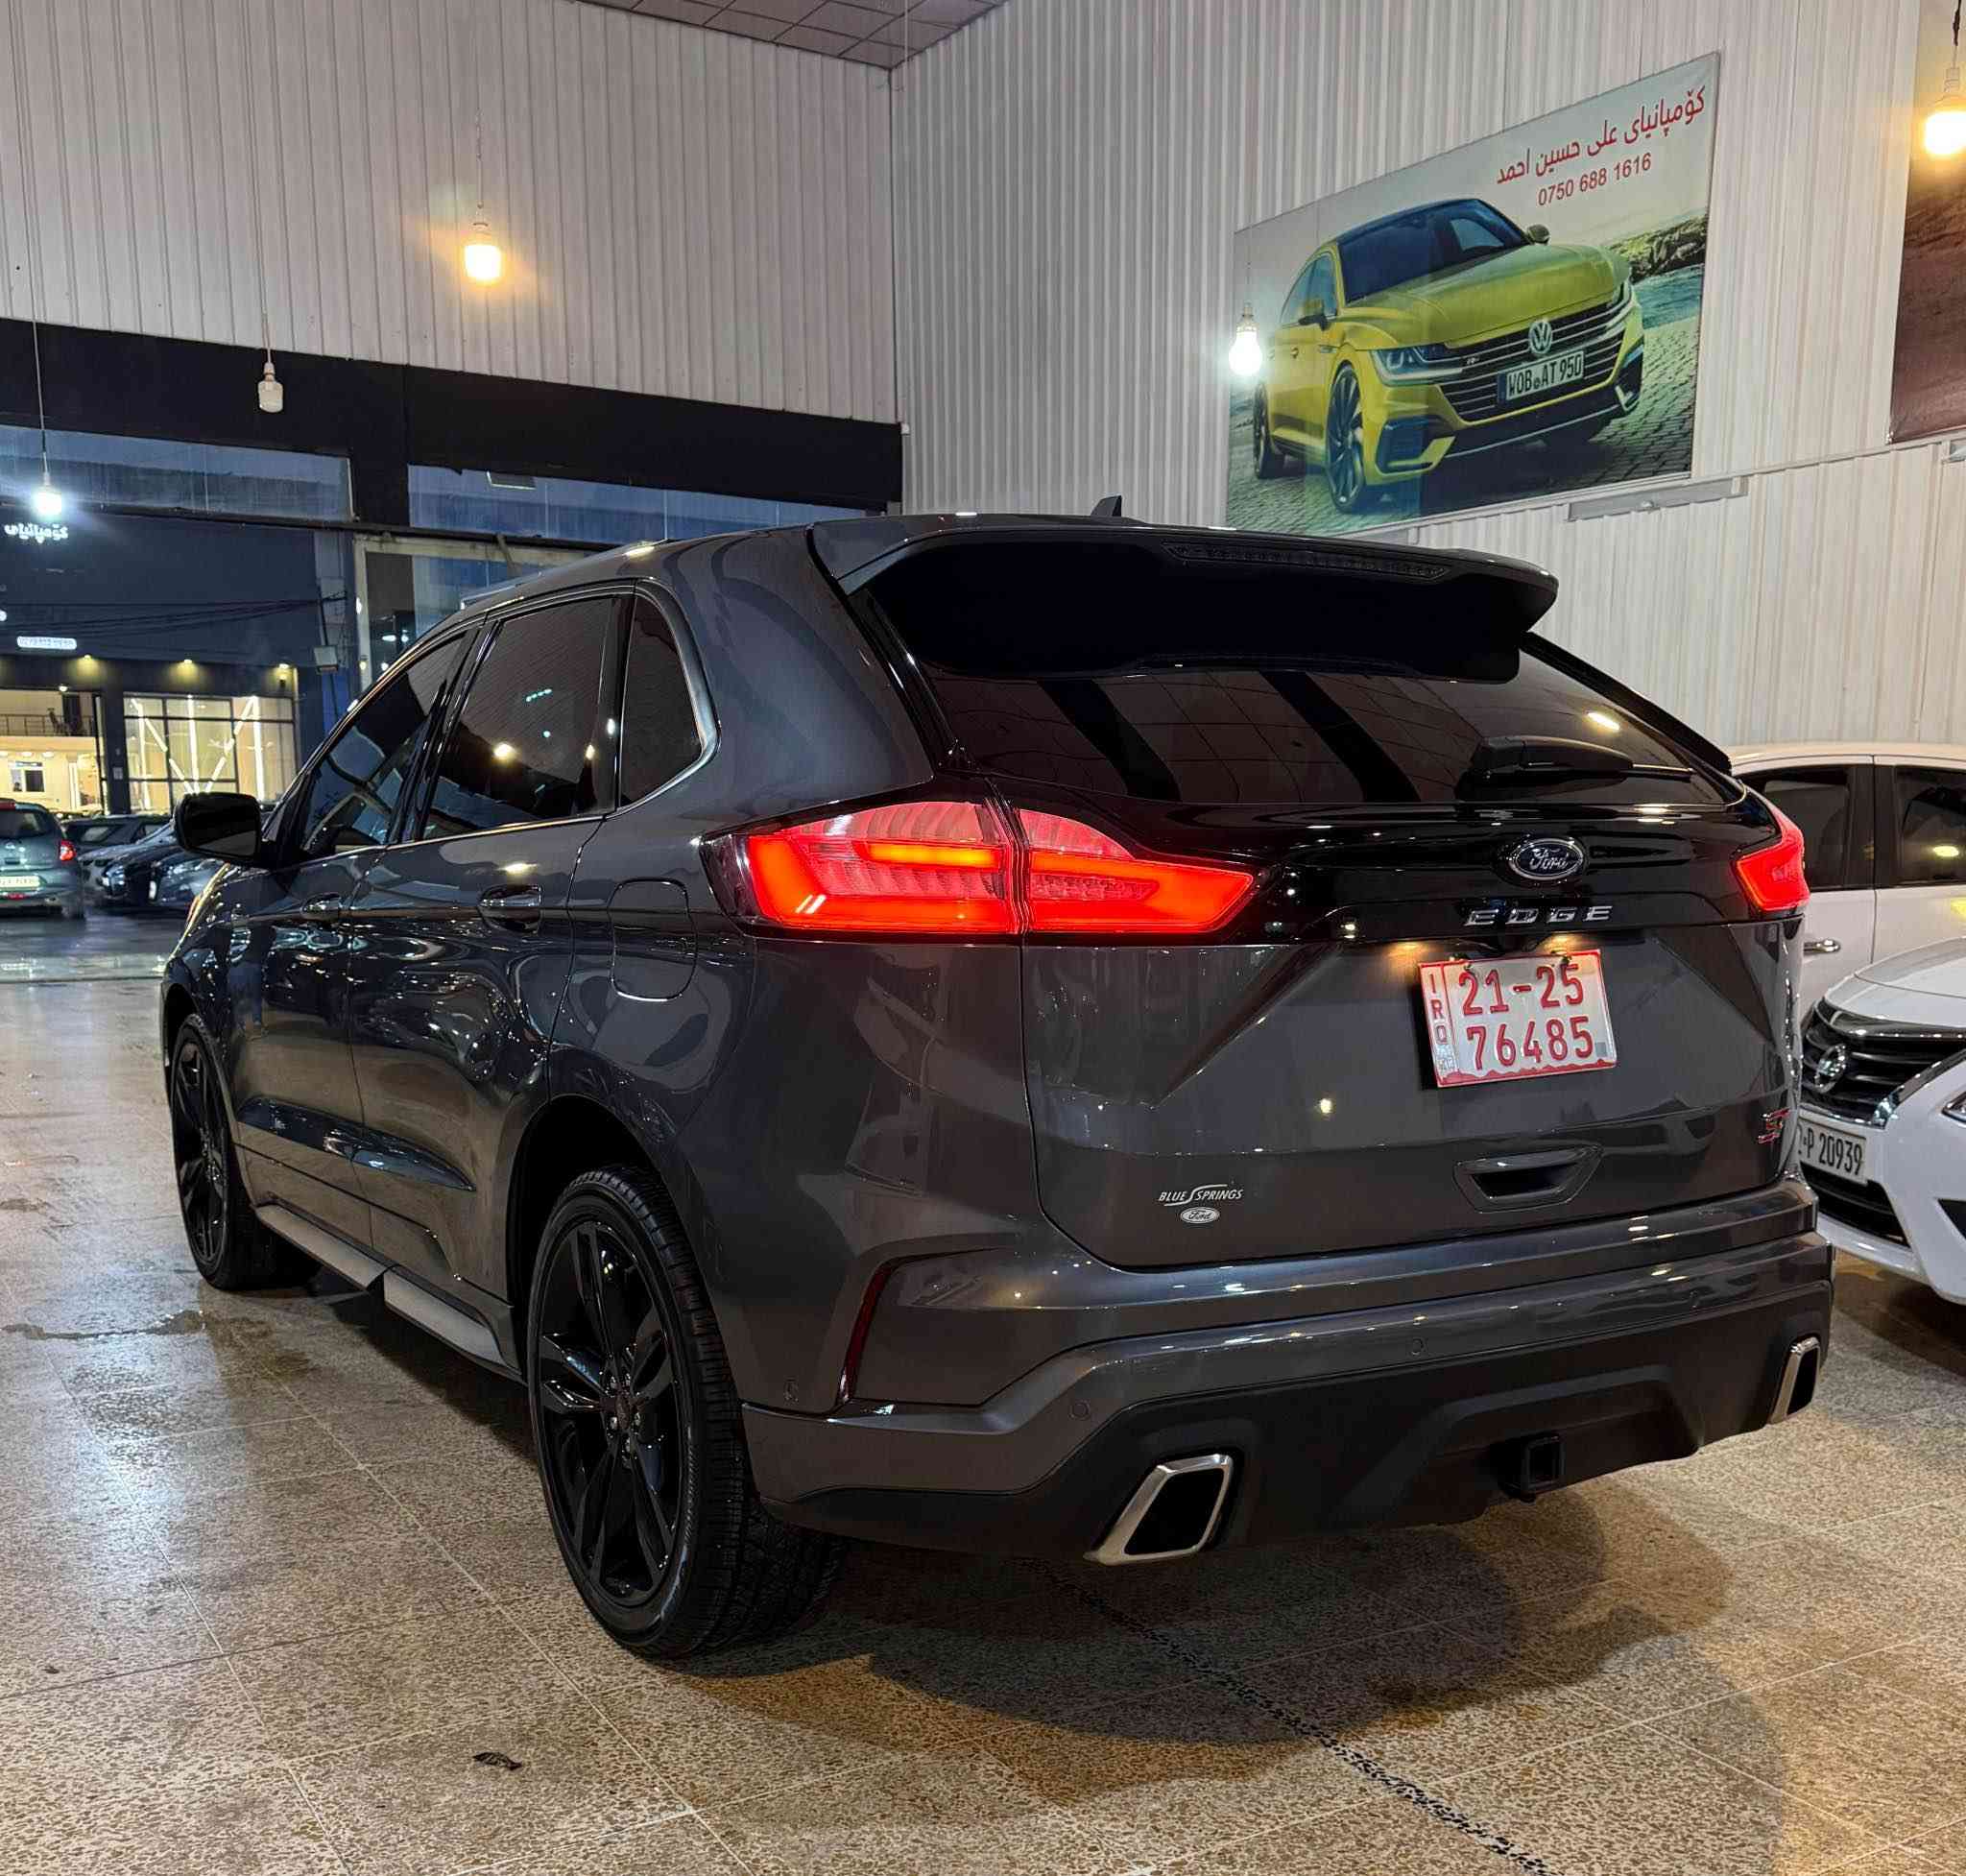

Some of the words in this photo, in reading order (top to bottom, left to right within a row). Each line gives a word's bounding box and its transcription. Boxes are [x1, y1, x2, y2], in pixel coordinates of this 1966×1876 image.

[1497, 148, 1531, 184] احمد
[1538, 179, 1574, 206] 0750
[1579, 168, 1608, 190] 688
[1614, 152, 1652, 180] 1616
[1559, 353, 1582, 381] 950
[1464, 905, 1613, 926] EDGE
[1458, 963, 1584, 1017] 21-25
[1466, 1016, 1594, 1071] 76485
[1818, 1133, 1862, 1176] 20939
[1158, 1191, 1188, 1202] BLUE
[1194, 1189, 1244, 1201] SPRINGS
